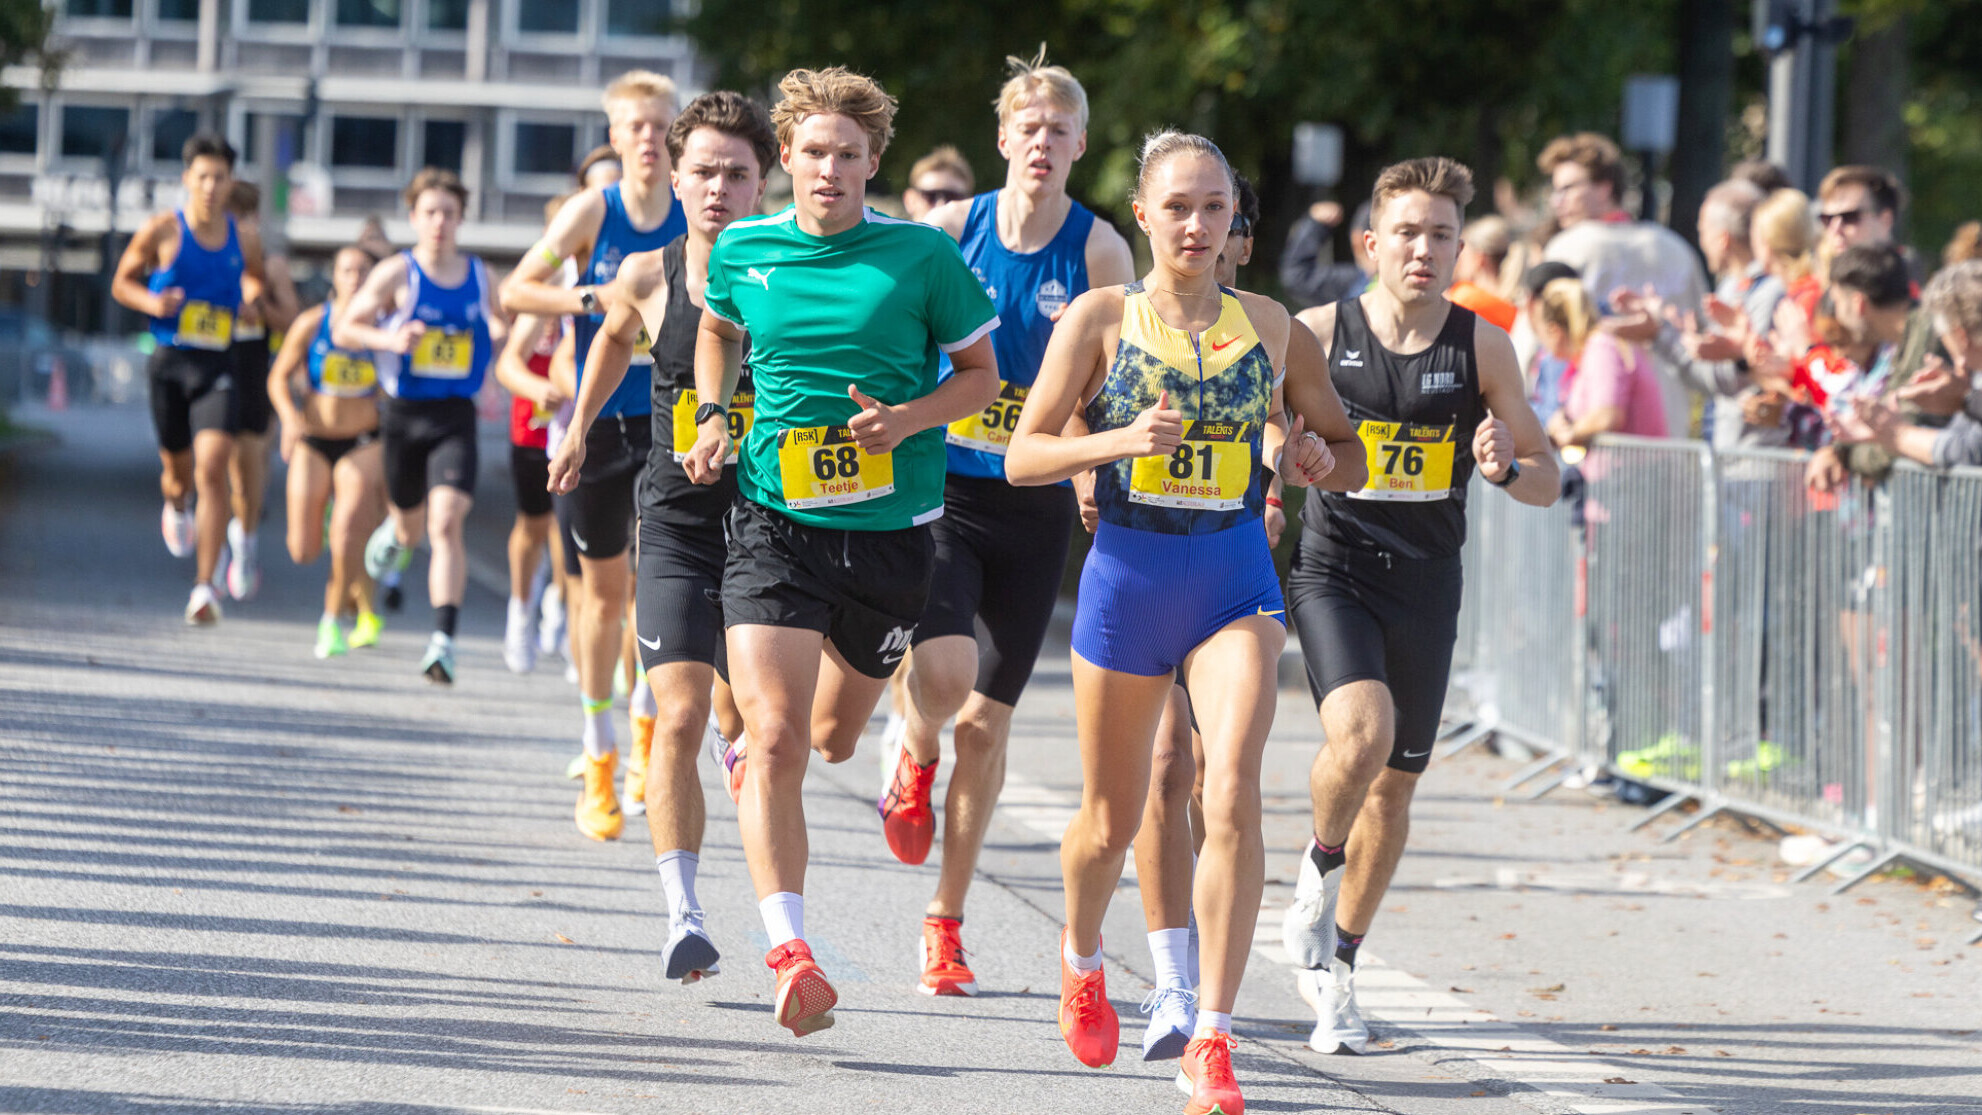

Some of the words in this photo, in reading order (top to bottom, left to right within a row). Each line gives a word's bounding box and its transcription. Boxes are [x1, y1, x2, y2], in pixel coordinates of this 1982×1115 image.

[727, 411, 744, 440] 9
[982, 402, 1023, 432] 56
[1203, 425, 1234, 435] TALENTS
[1409, 427, 1441, 437] TALENTS
[813, 446, 860, 480] 68
[1169, 443, 1213, 480] 81
[1381, 444, 1424, 476] 76
[820, 480, 859, 494] Teetje
[1162, 481, 1221, 496] Vanessa
[1389, 478, 1413, 489] Ben
